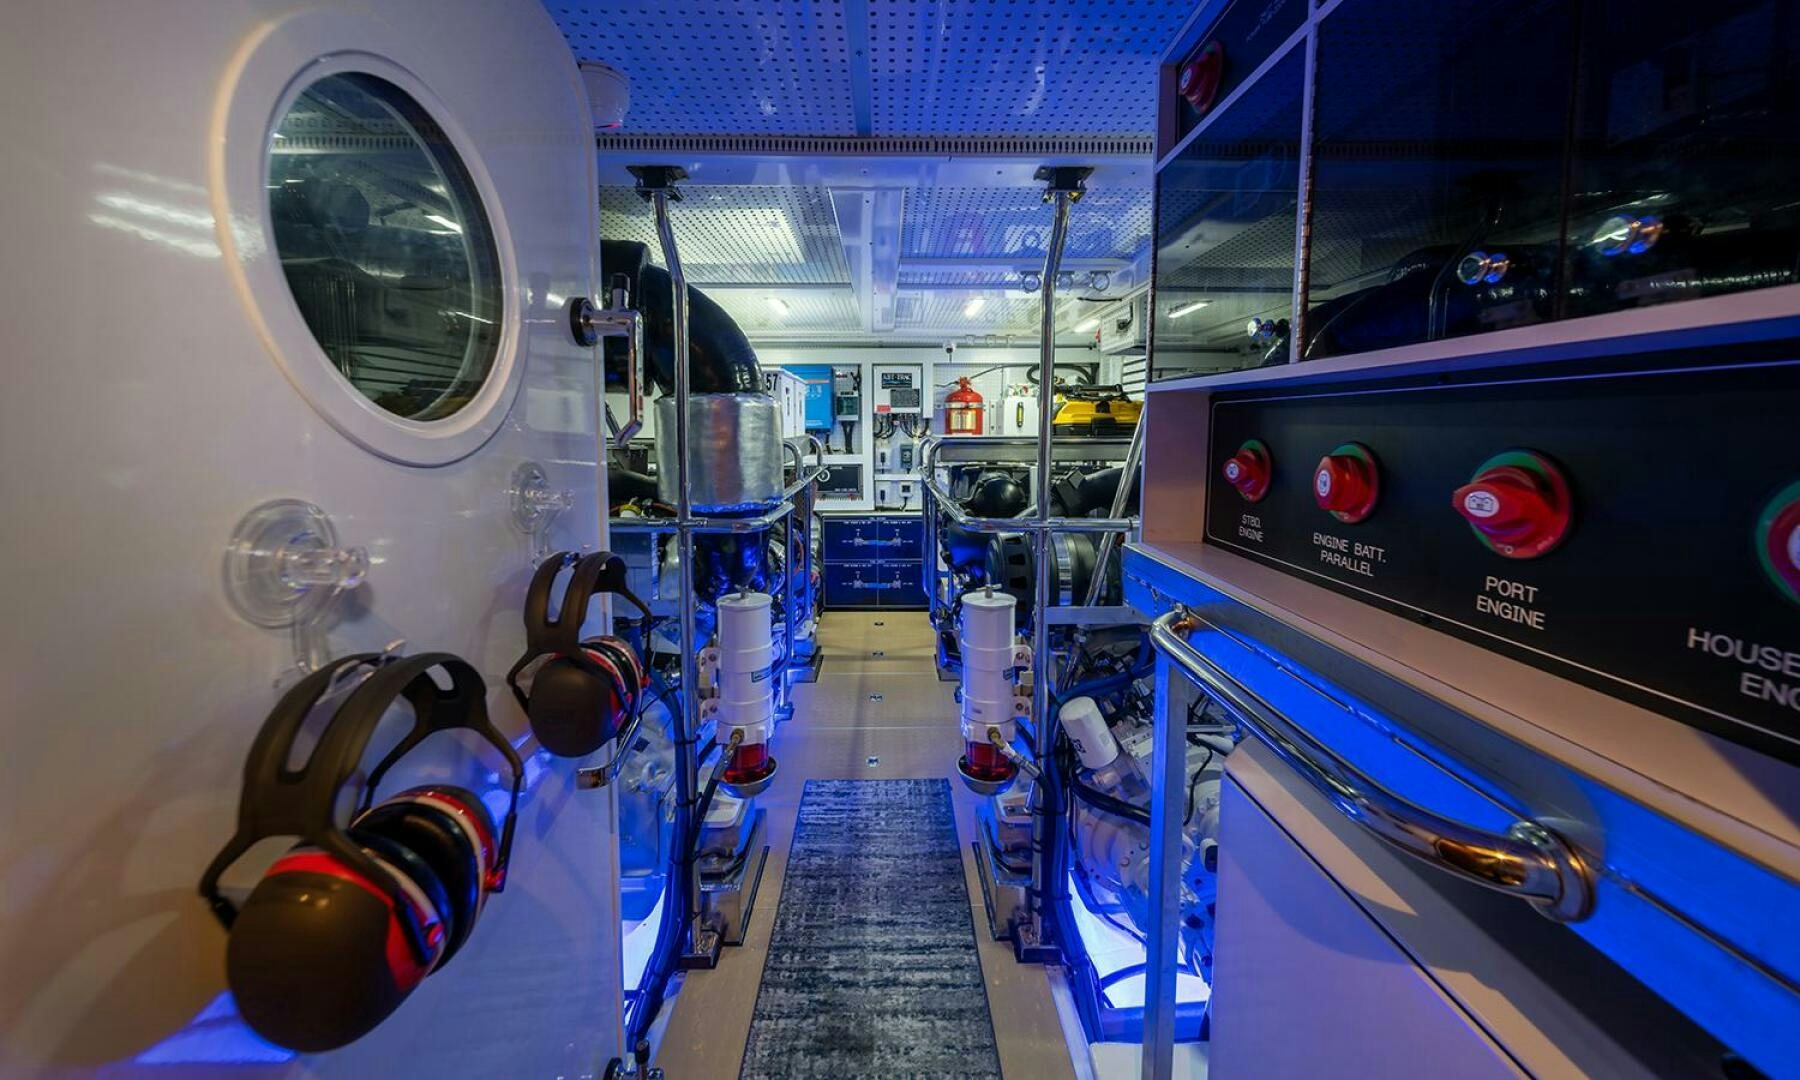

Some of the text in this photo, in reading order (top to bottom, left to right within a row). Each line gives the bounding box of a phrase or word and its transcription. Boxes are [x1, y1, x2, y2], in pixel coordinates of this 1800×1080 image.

[1239, 526, 1265, 544] ENGINE
[1313, 532, 1387, 563] ENGINE BATT.
[1320, 550, 1374, 577] PARALLEL
[1485, 575, 1538, 603] PORT
[1476, 595, 1546, 630] ENGINE
[1687, 627, 1800, 678] HOUSE
